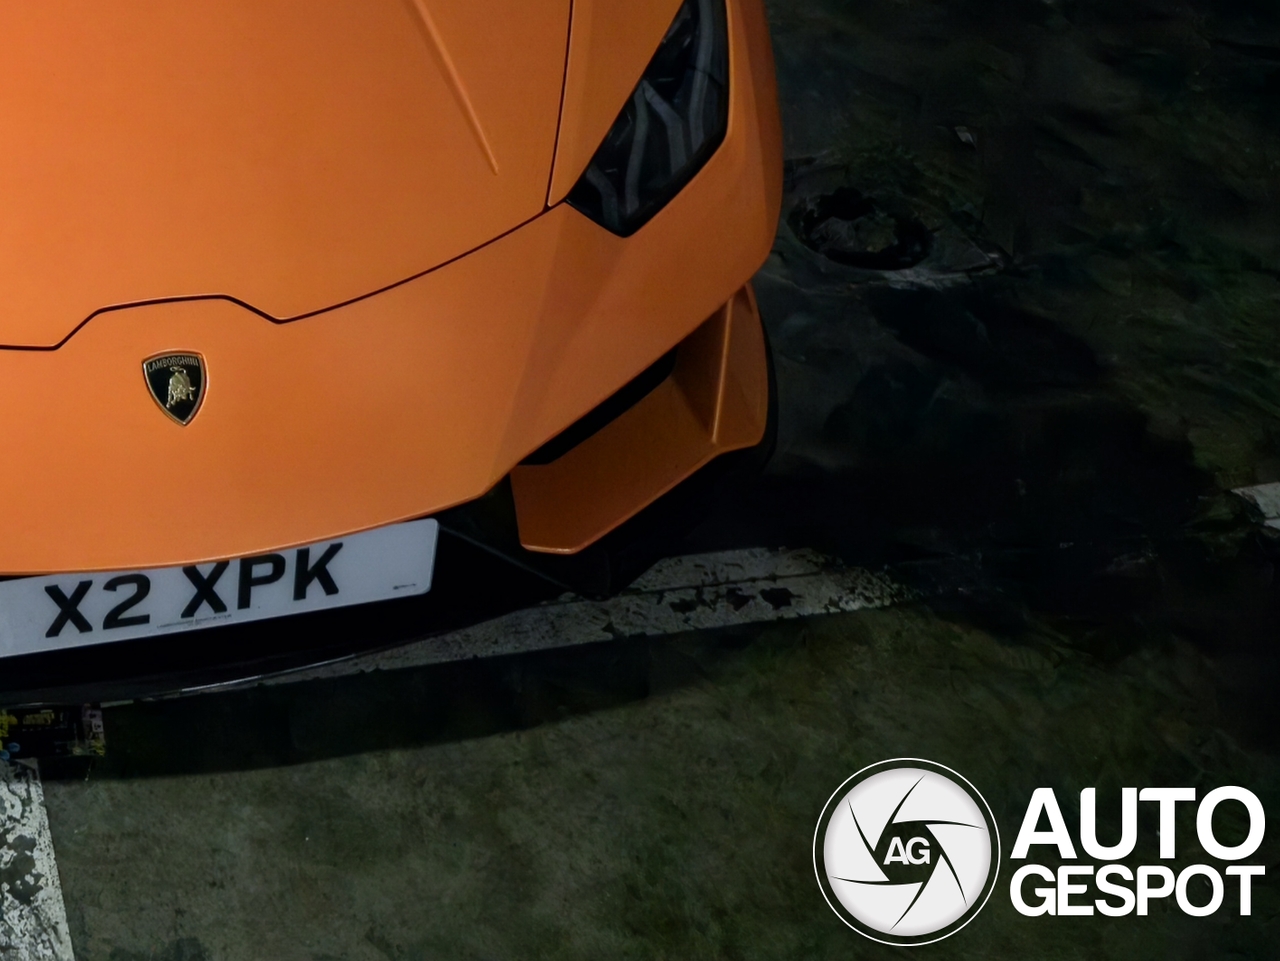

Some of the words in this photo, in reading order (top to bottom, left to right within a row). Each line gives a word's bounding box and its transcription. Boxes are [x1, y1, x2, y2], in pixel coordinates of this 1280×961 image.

[147, 356, 199, 373] LAMBORGHINI
[44, 573, 151, 638] X2
[180, 542, 344, 619] XPK
